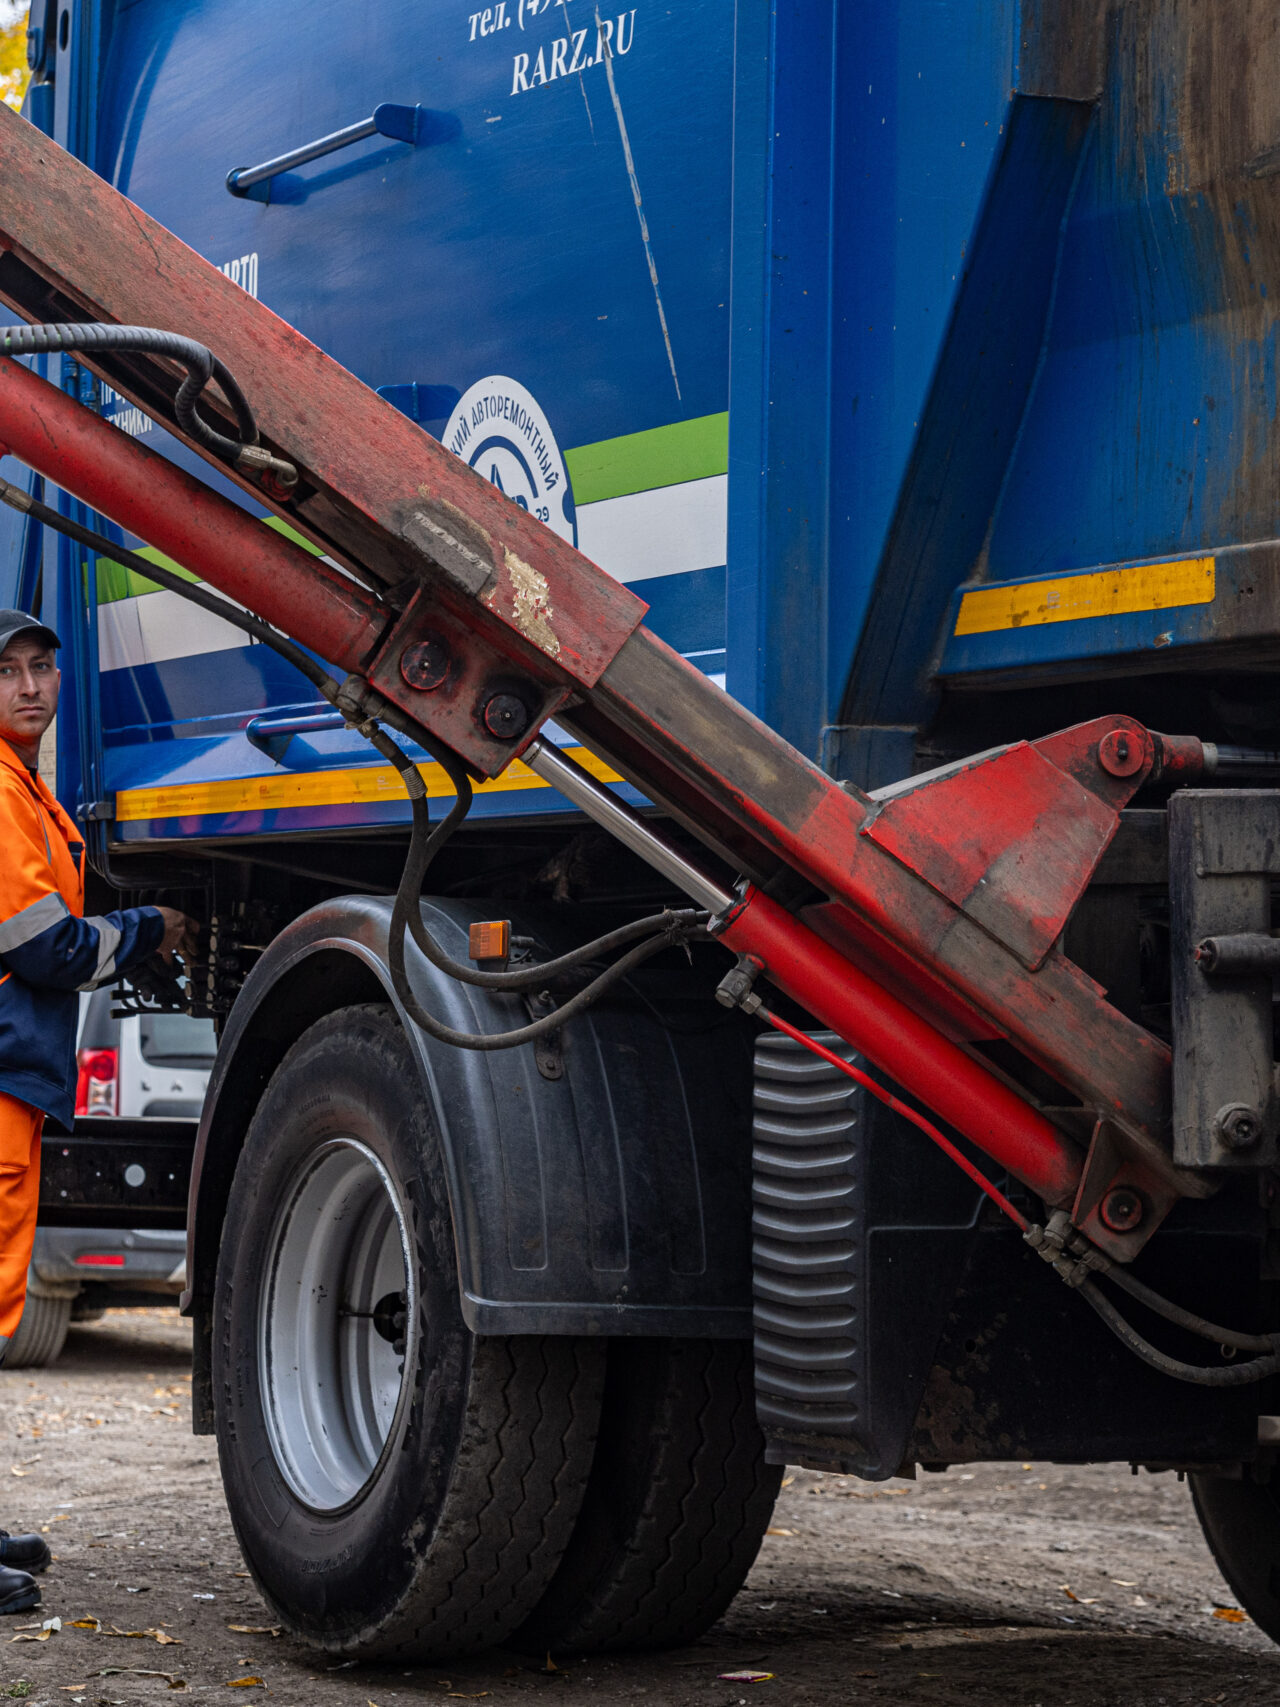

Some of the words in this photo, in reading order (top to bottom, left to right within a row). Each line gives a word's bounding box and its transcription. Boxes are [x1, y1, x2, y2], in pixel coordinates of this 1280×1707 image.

[468, 1, 511, 42] тел.
[510, 9, 637, 96] RARZ.RU
[472, 395, 559, 491] АВТОРЕМОНТНЫЙ
